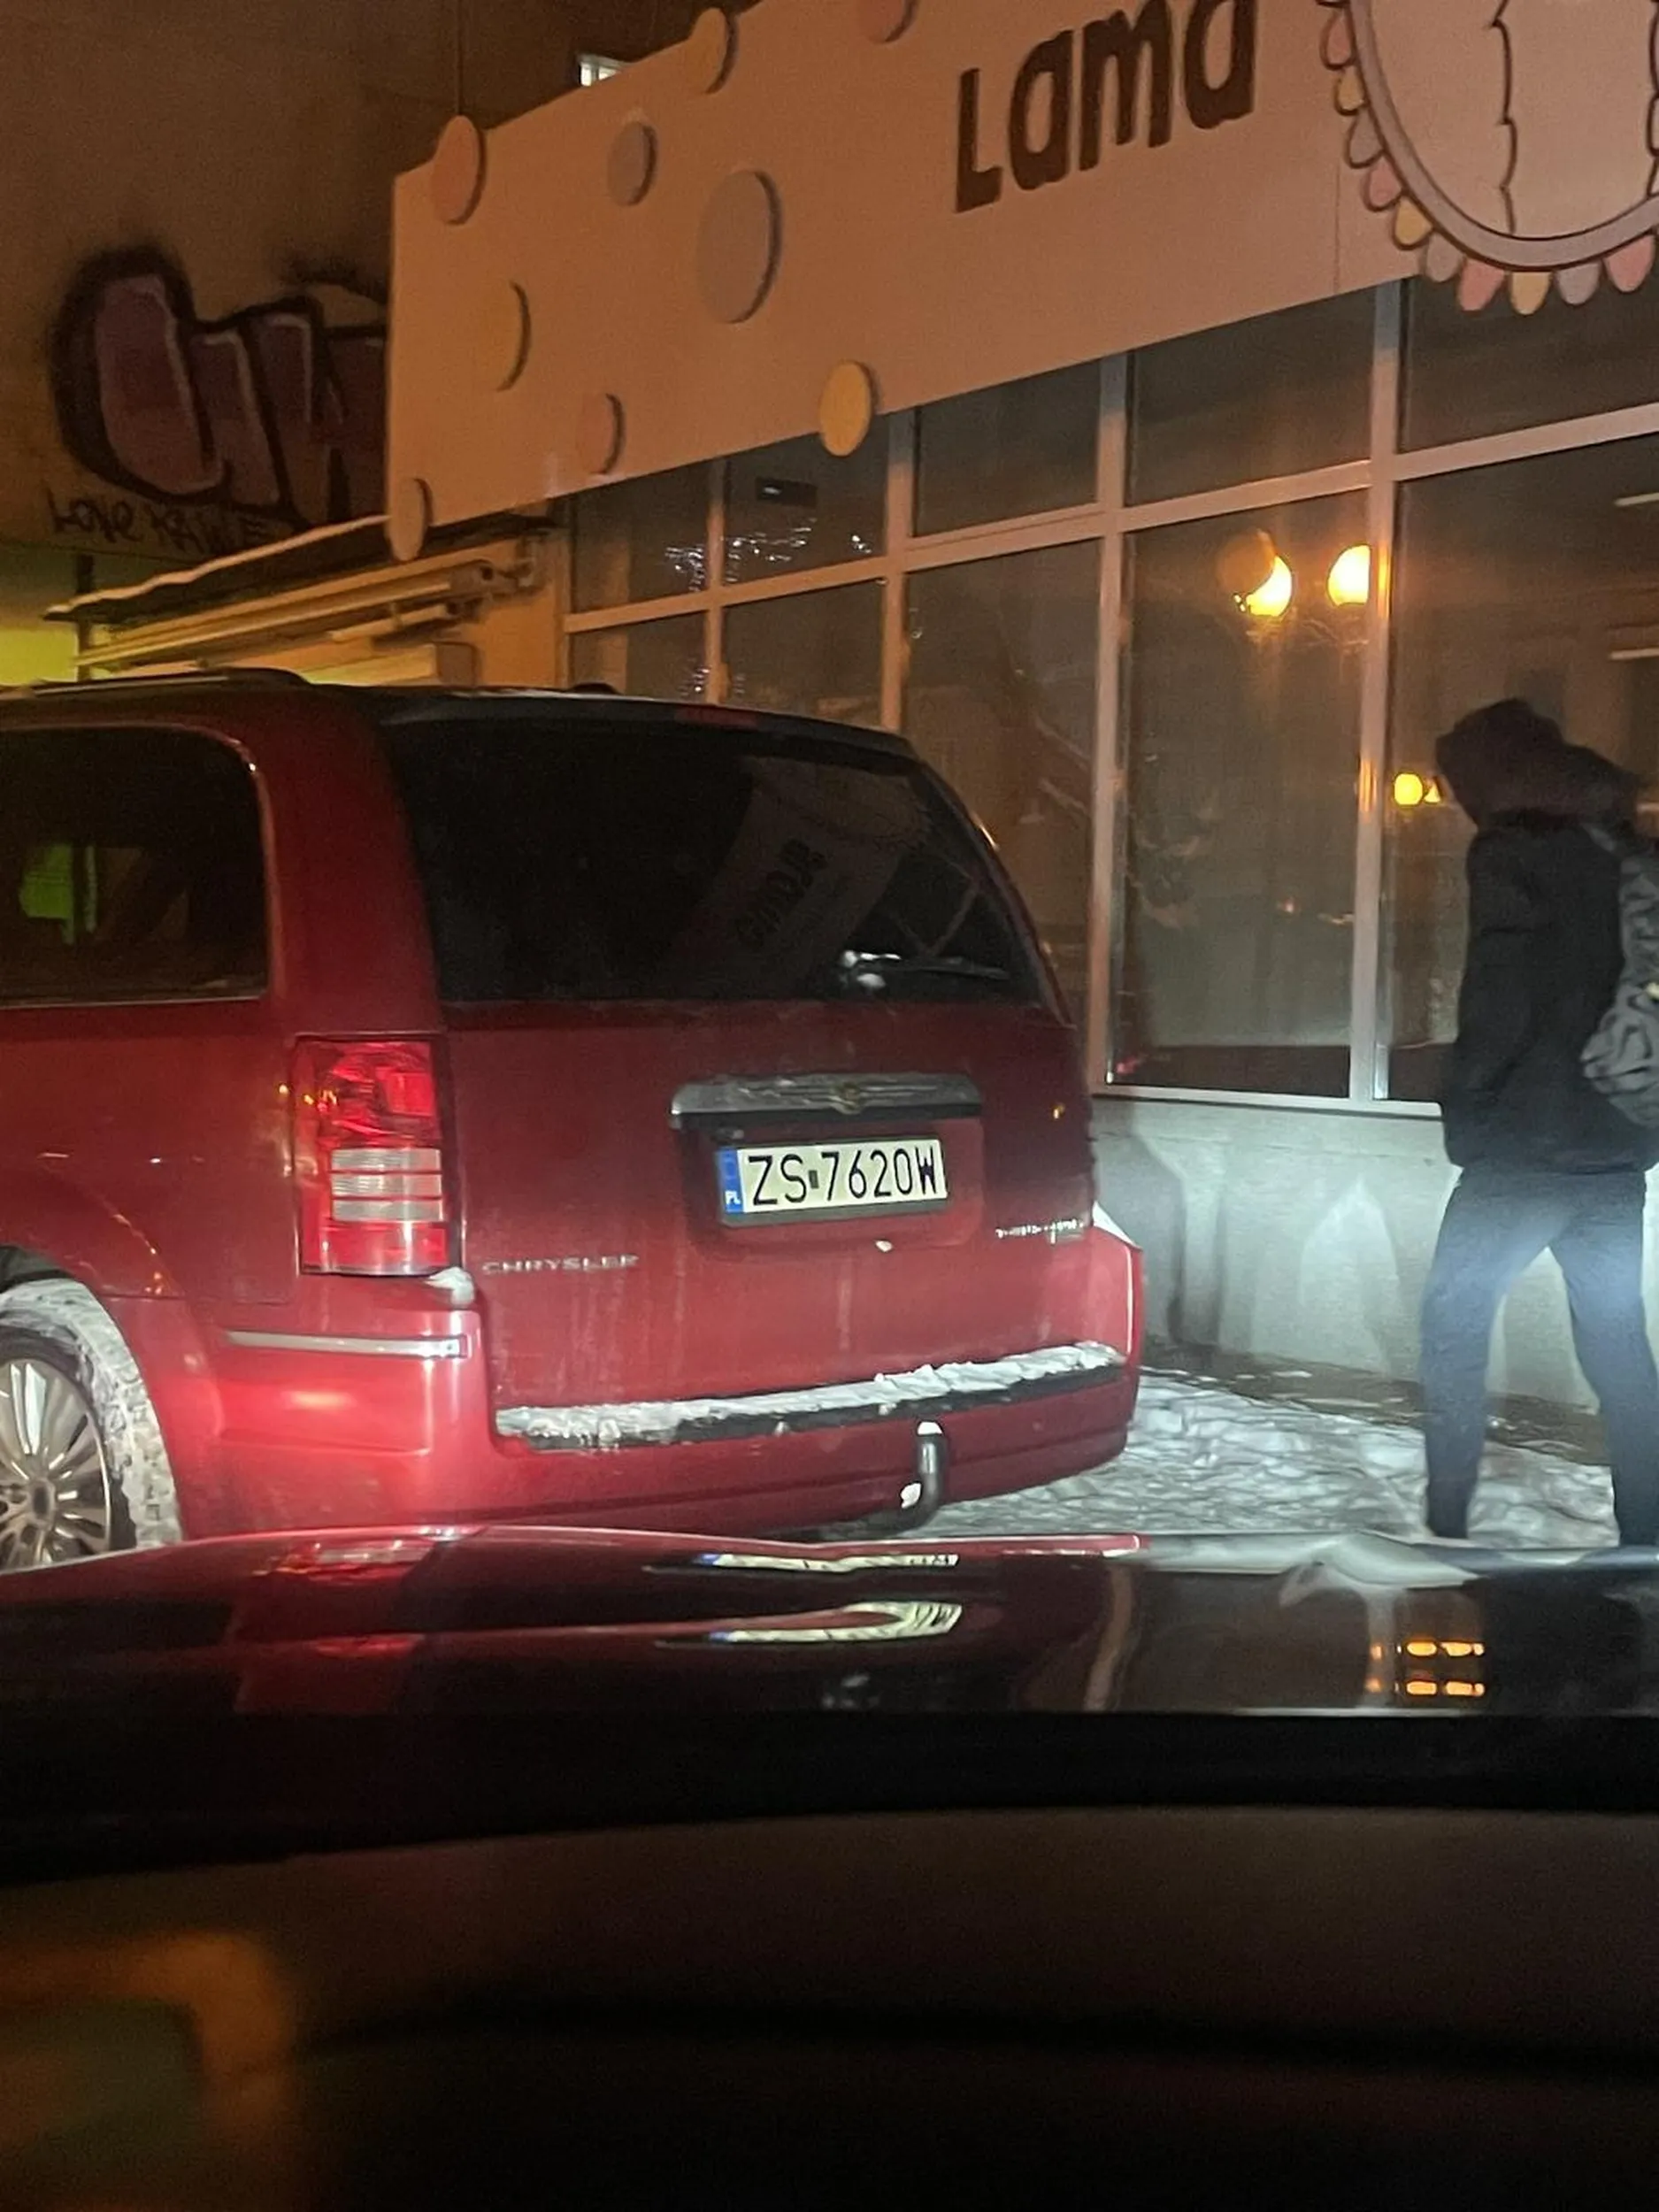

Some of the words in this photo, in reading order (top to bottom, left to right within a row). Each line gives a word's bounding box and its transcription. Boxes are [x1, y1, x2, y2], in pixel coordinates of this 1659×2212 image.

[956, 0, 1256, 213] Lama
[748, 1153, 808, 1206] ZS
[820, 1146, 938, 1202] 7620W
[724, 1190, 741, 1206] PL
[482, 1253, 640, 1274] CHRYSLER
